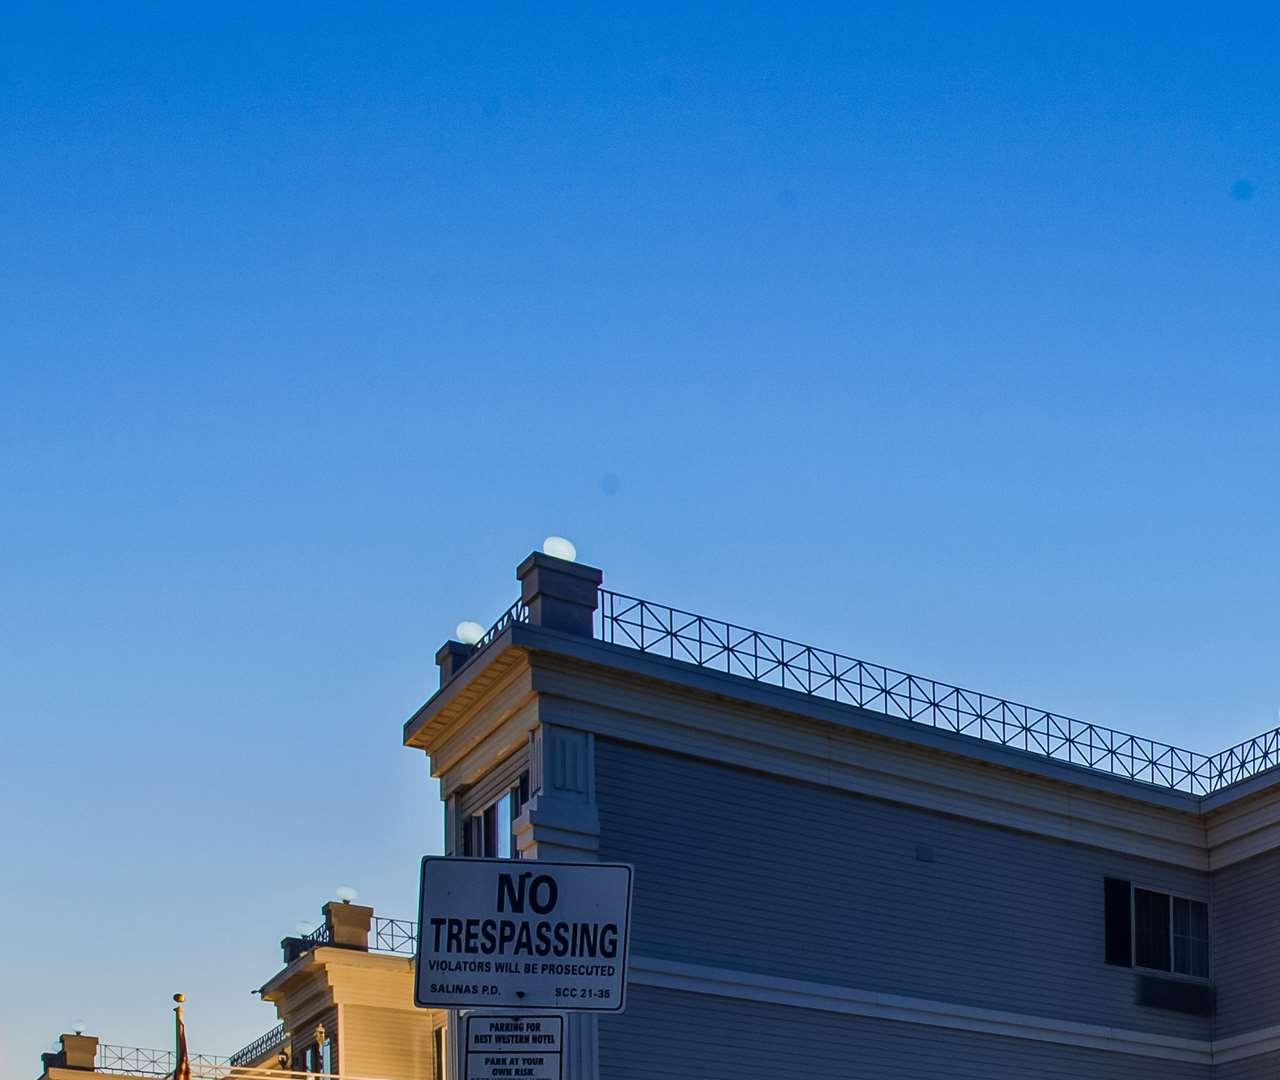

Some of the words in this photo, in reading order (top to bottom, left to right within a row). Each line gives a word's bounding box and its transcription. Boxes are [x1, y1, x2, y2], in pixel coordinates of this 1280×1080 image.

[497, 874, 558, 914] NO
[430, 918, 618, 958] TRESPASSING
[429, 960, 491, 973] VIOLATORS
[495, 962, 520, 974] WILL
[524, 963, 538, 974] BE
[541, 963, 615, 976] PROSECUTED
[430, 983, 479, 994] SALINAS
[555, 987, 577, 997] SCC
[580, 988, 610, 998] 21-35
[489, 1022, 524, 1032] PARKING
[526, 1022, 541, 1032] FOR
[474, 1034, 493, 1044] BEST
[495, 1034, 530, 1044] WESTERN
[532, 1034, 555, 1044] HOTEL
[484, 1057, 507, 1066] PARK
[509, 1057, 519, 1066] AT
[522, 1057, 544, 1066] YOUR
[492, 1068, 512, 1076] OWN
[514, 1068, 534, 1076] RISK
